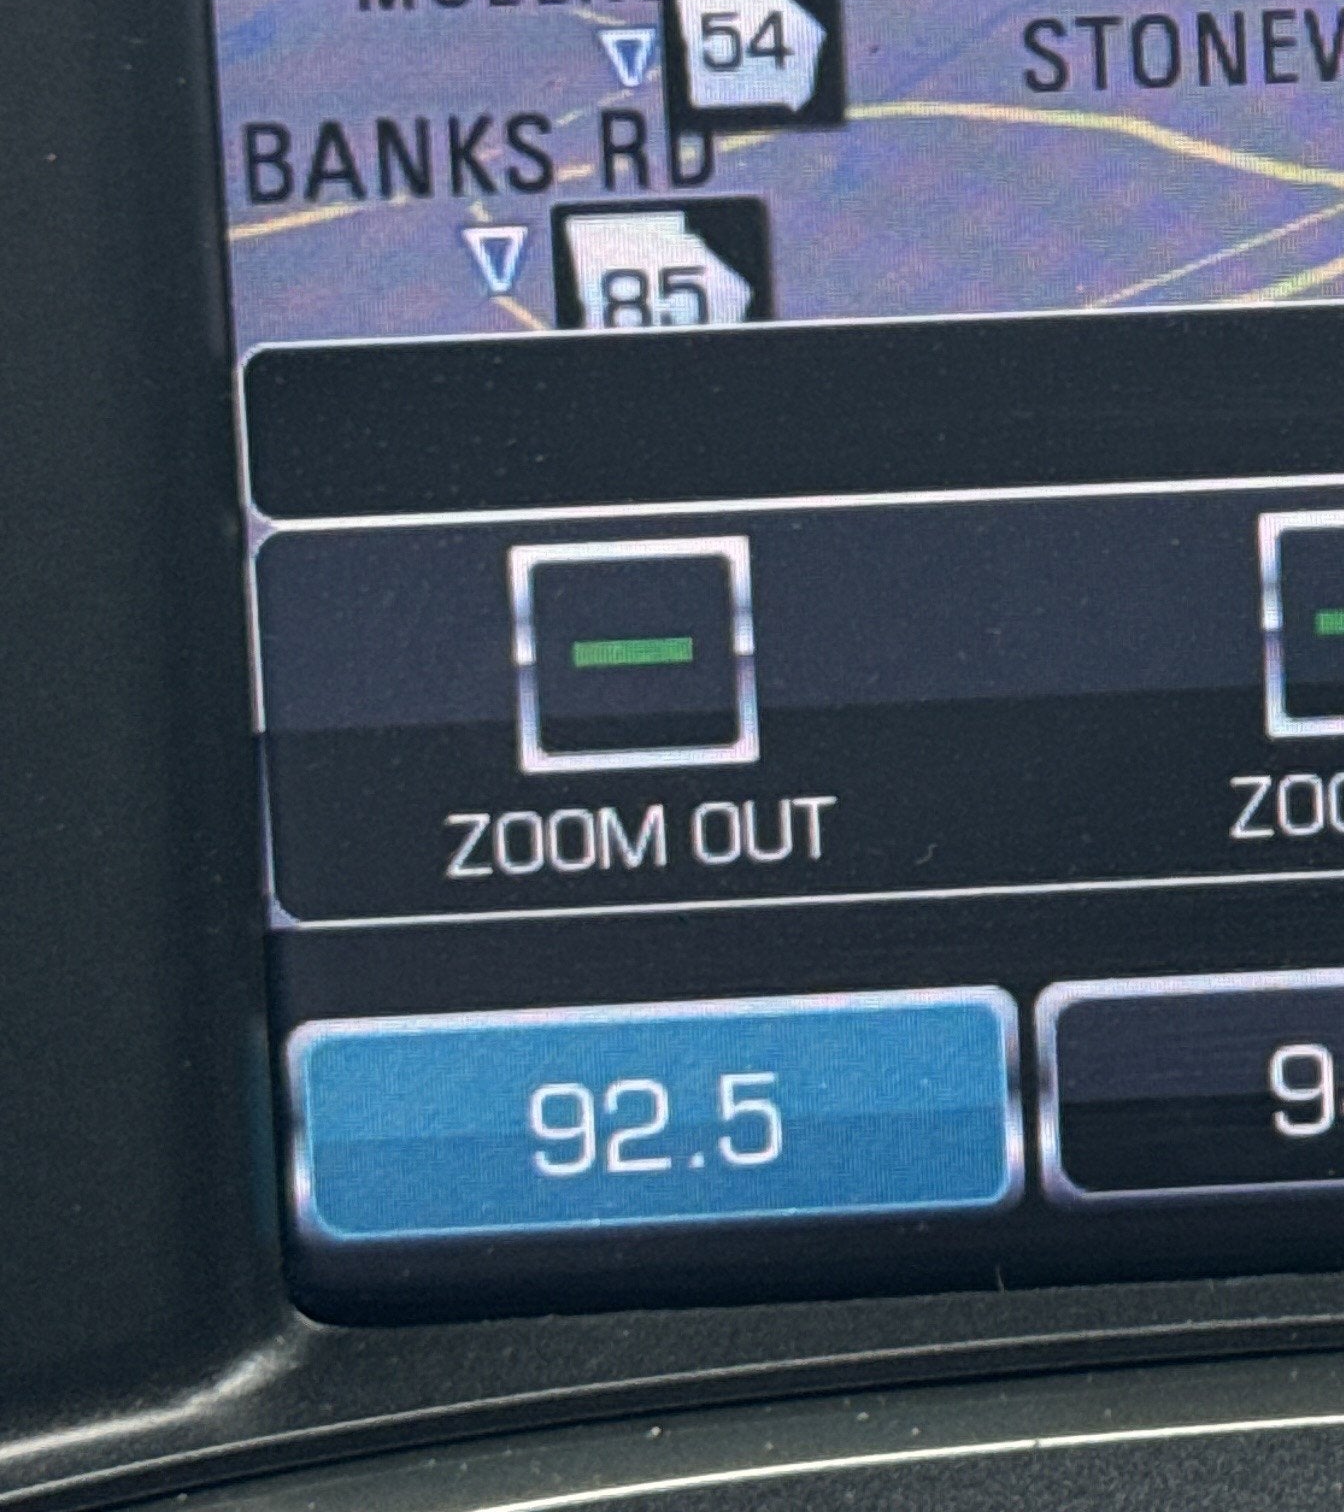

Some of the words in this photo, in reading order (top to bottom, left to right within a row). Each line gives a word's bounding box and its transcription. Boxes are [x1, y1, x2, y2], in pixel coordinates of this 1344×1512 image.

[701, 9, 795, 72] 54
[244, 112, 555, 205] BANKS
[600, 108, 715, 190] RD
[601, 265, 709, 328] 85
[445, 803, 669, 880] ZOOM
[691, 794, 838, 866] OUT
[528, 1071, 785, 1178] 92.5
